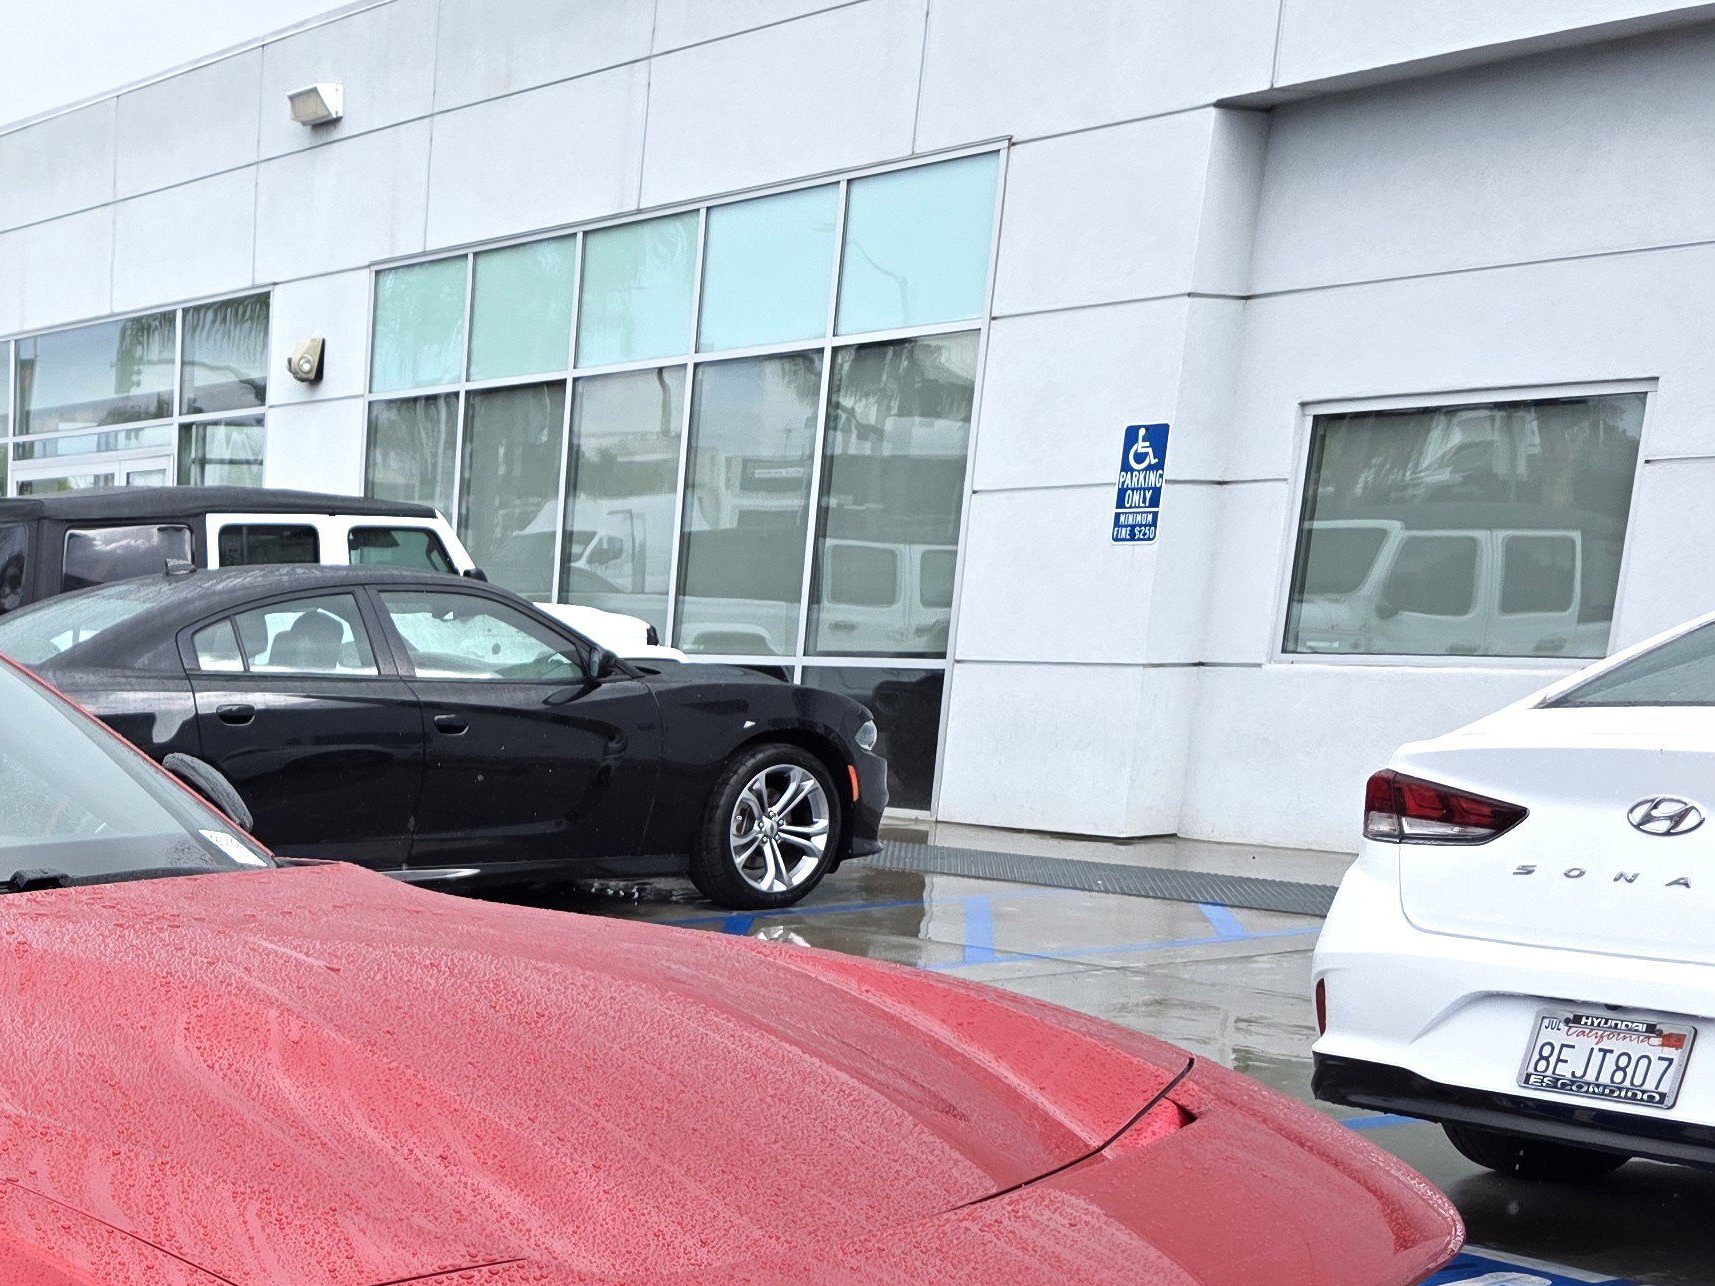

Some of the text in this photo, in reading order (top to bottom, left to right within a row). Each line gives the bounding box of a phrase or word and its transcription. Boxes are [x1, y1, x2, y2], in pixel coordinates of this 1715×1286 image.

[1118, 470, 1164, 488] PARKING
[1124, 490, 1153, 507] ONLY
[1119, 513, 1153, 525] MINIMUM
[1113, 526, 1155, 540] FINE $250
[1544, 1018, 1562, 1032] JUL
[1580, 1016, 1647, 1032] HYUNDAI
[1565, 1026, 1662, 1046] California
[1533, 1041, 1675, 1091] 8EJT807
[1528, 1074, 1660, 1103] ESCONDIDO
